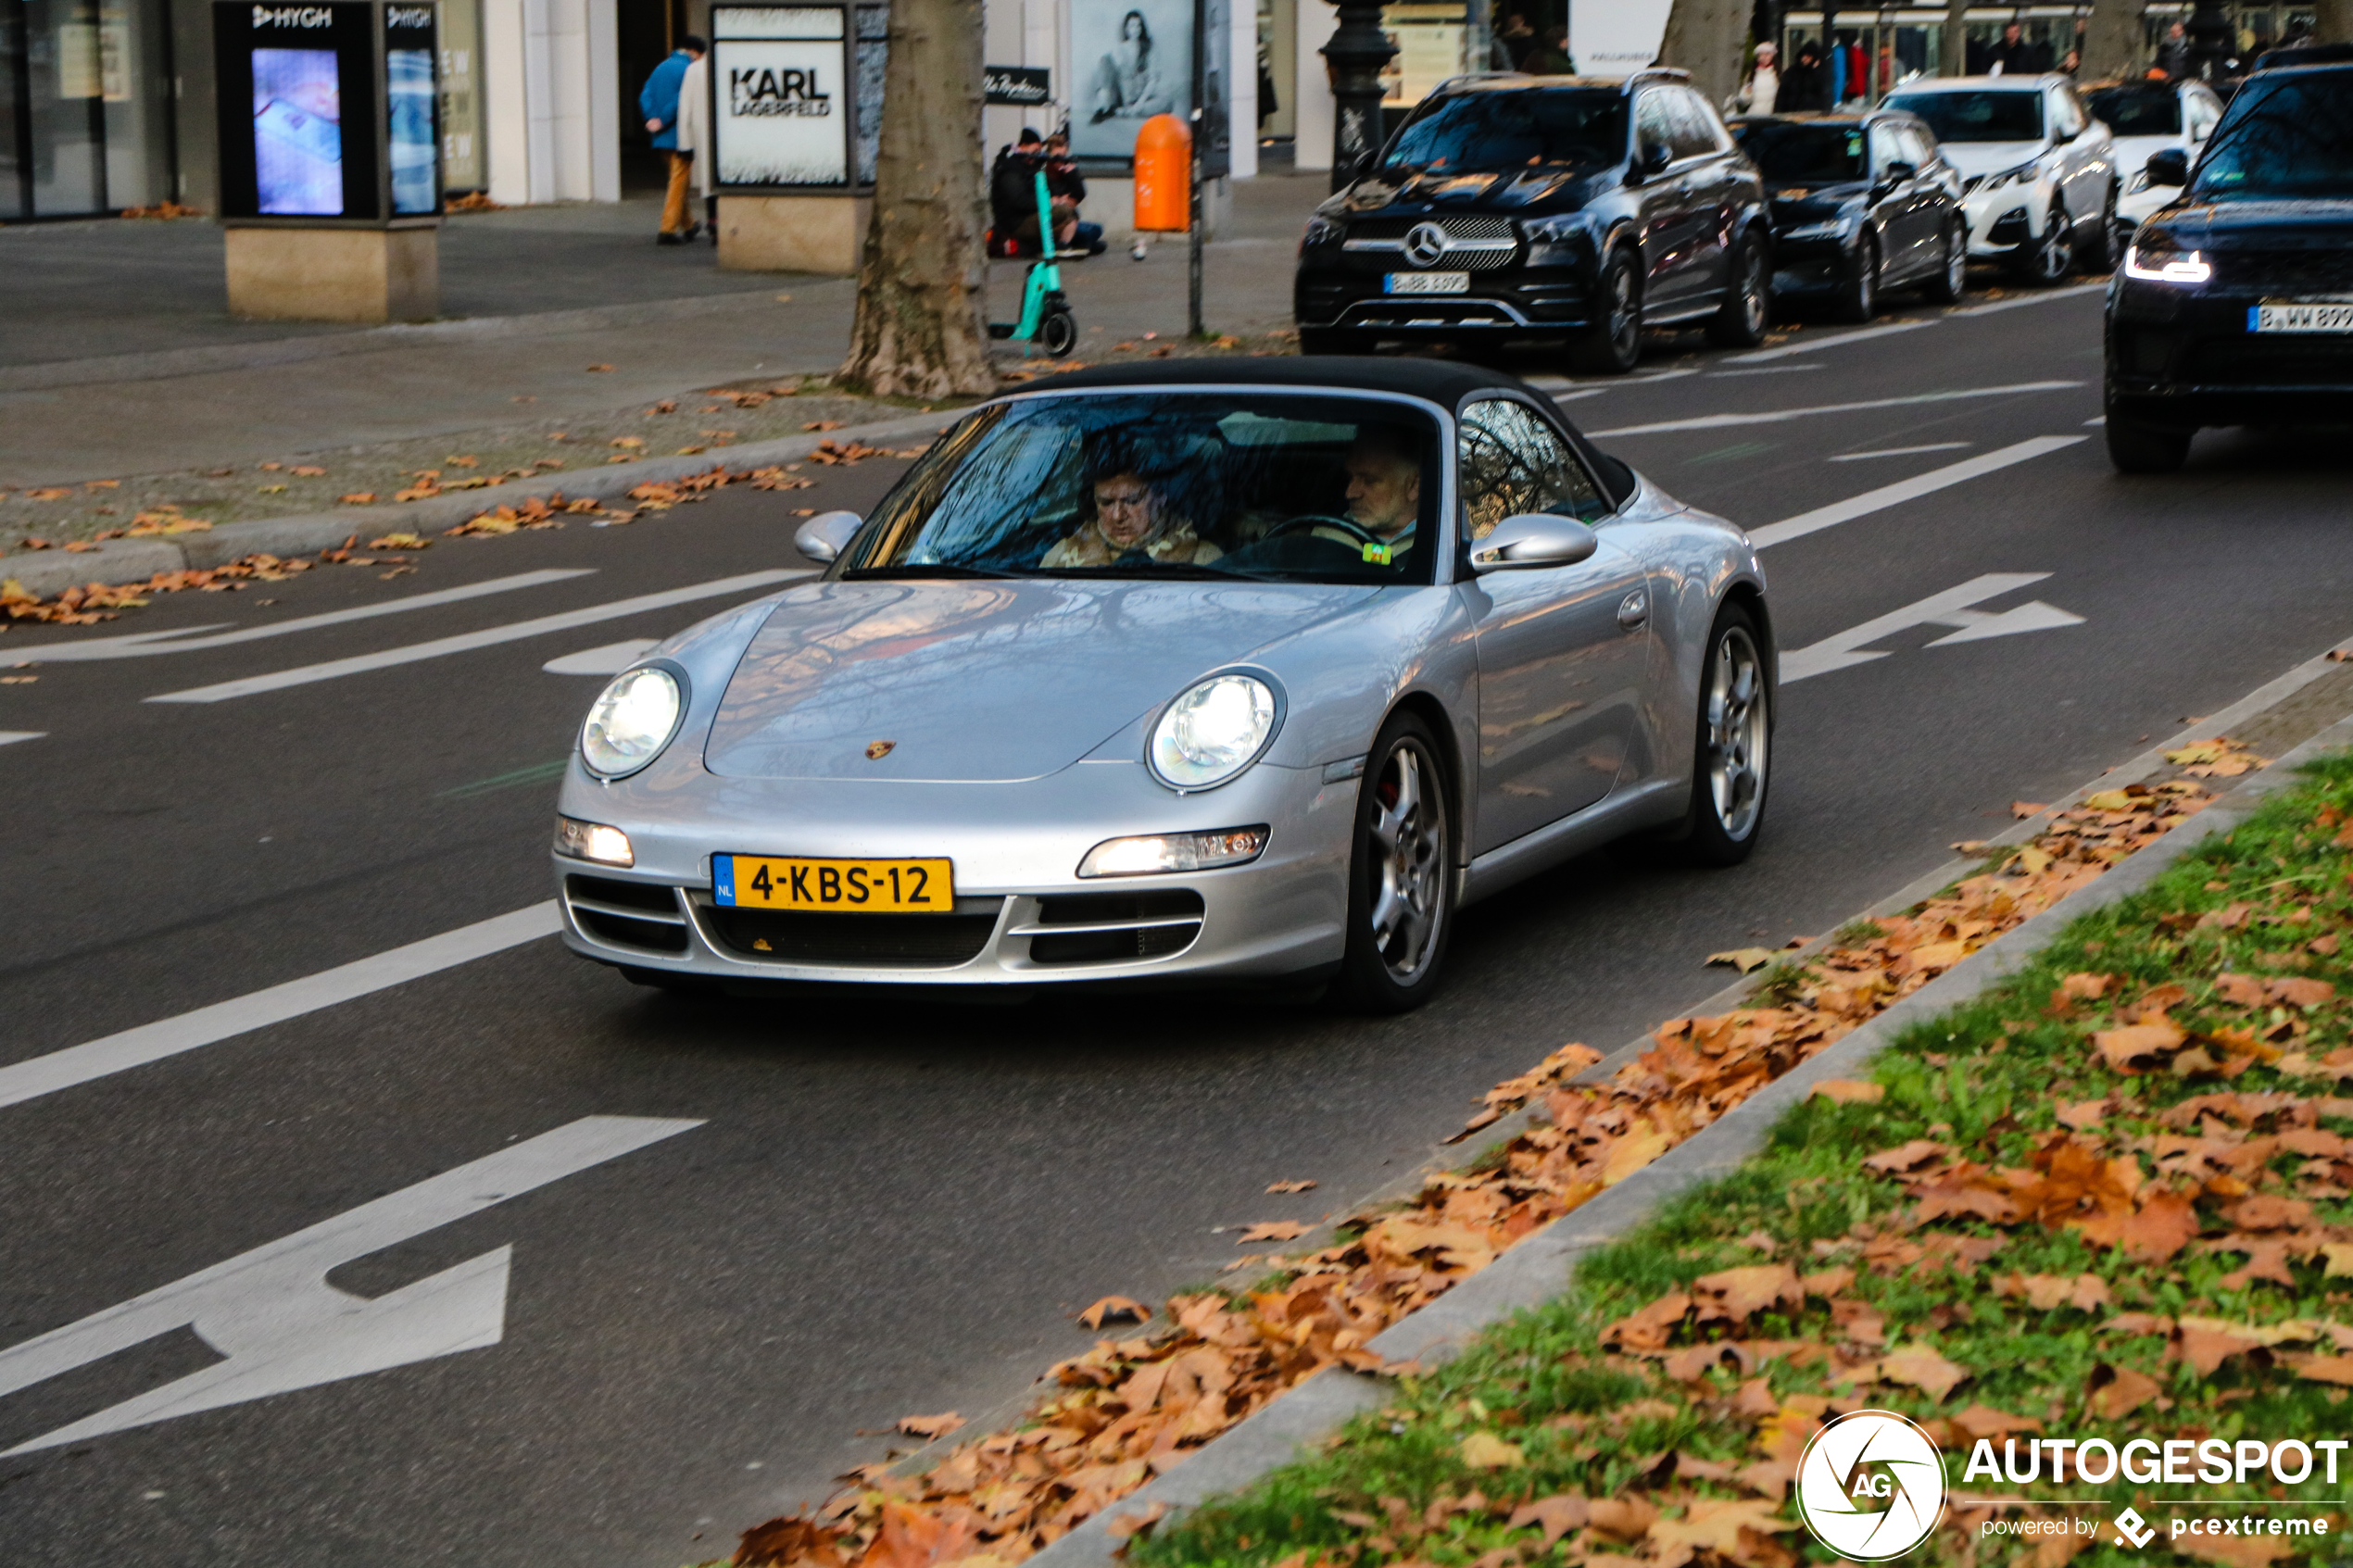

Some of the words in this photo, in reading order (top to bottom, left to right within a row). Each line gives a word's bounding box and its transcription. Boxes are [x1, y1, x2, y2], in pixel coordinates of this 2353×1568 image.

[273, 6, 333, 29] HYGH
[398, 6, 432, 29] HYGH
[441, 49, 470, 76] EW
[731, 68, 830, 100] KARL
[731, 100, 831, 118] LAGERFELD
[444, 132, 472, 160] EW
[2260, 307, 2272, 328] B
[2285, 307, 2314, 328] WW
[718, 884, 733, 898] NL
[750, 864, 931, 904] 4-KBS-12
